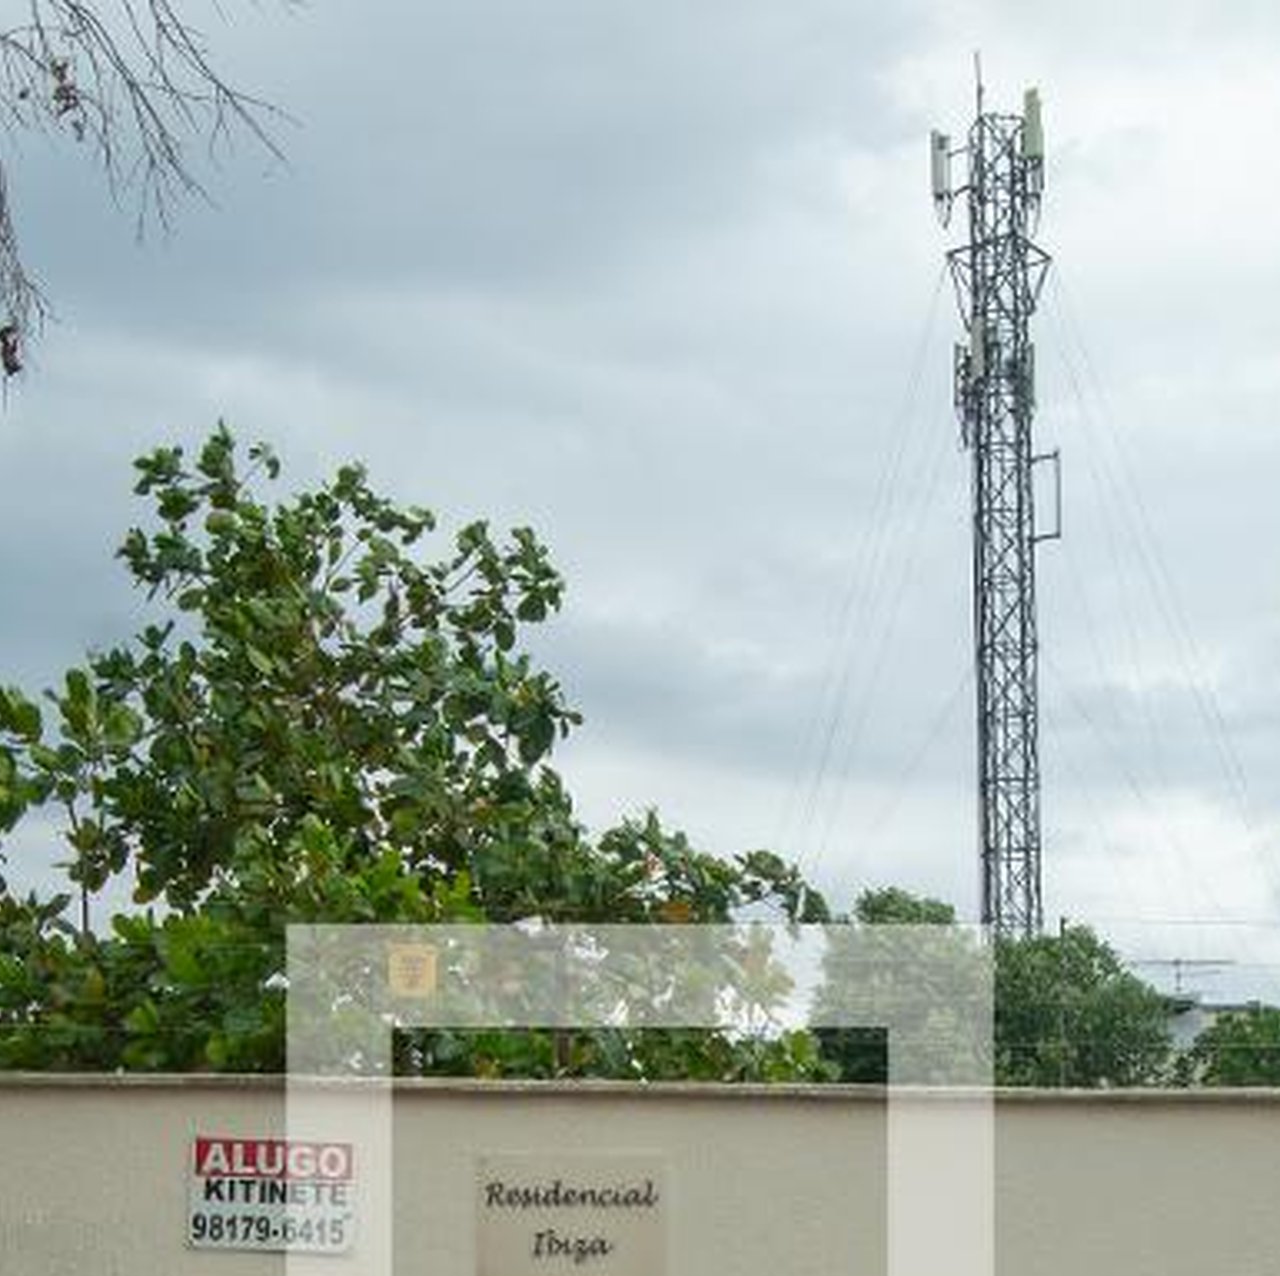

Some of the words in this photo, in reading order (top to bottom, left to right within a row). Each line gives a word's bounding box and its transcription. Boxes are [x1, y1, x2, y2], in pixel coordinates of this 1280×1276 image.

[201, 1142, 348, 1178] ALUGO
[204, 1179, 347, 1207] KITINETE
[485, 1179, 660, 1209] Residencial
[533, 1228, 614, 1266] Ibiza
